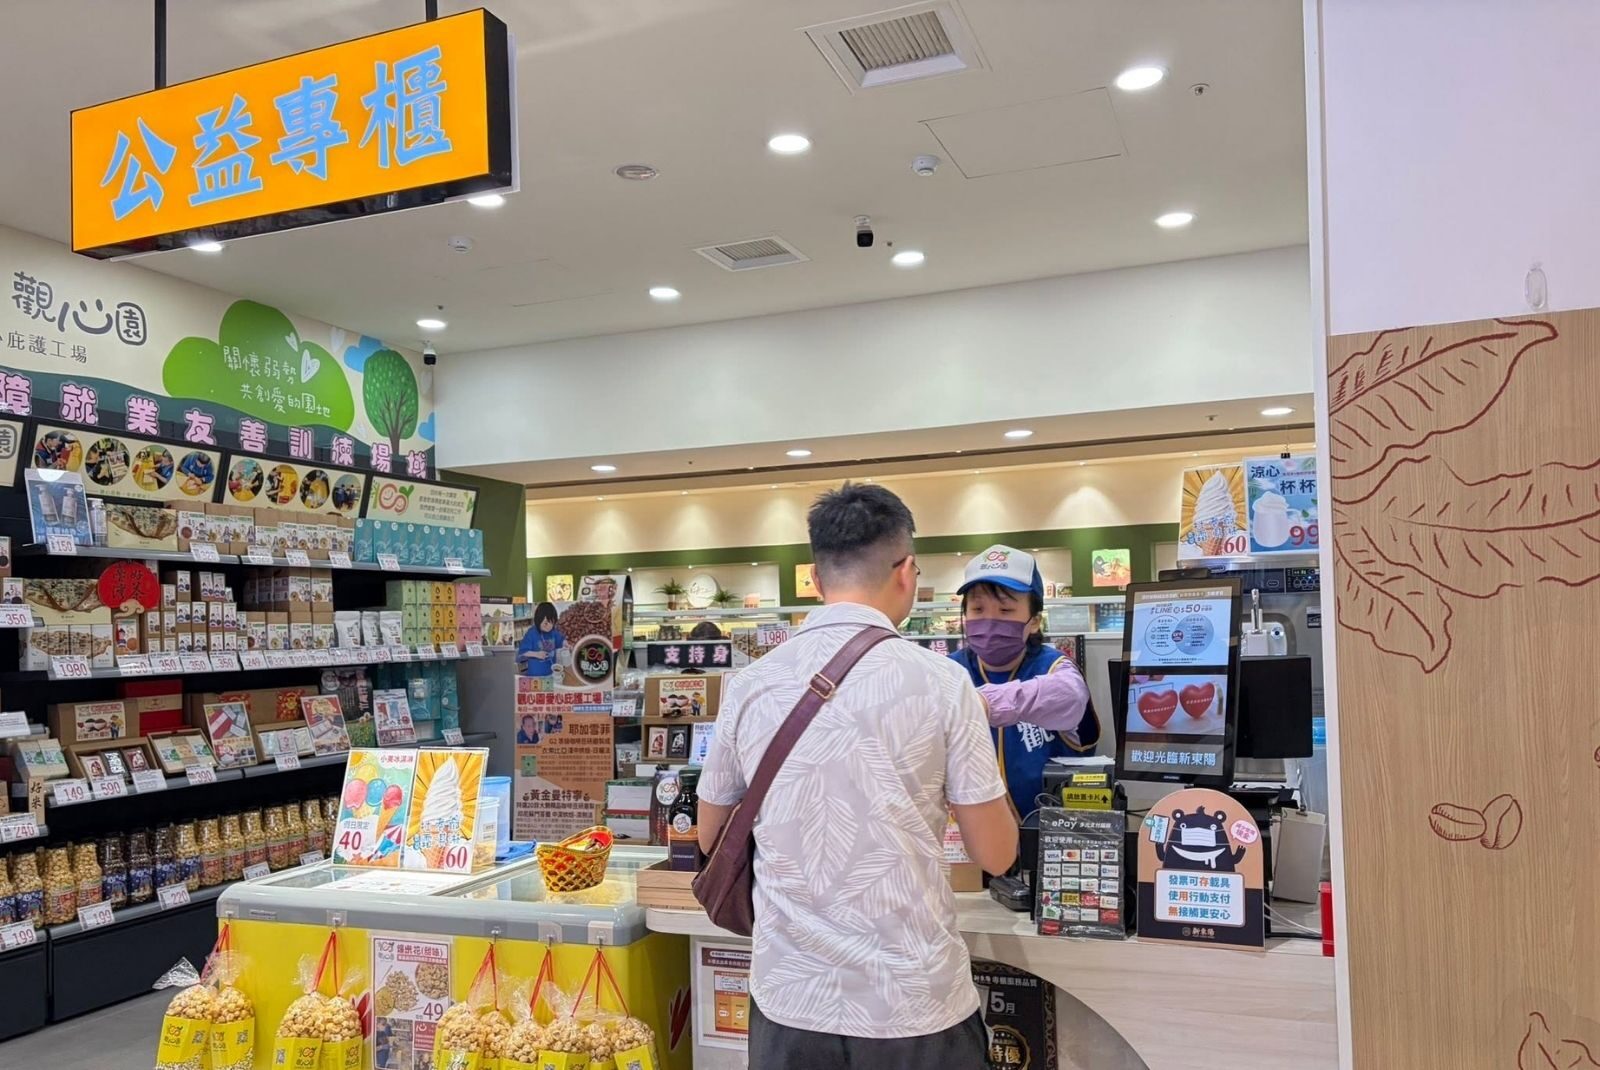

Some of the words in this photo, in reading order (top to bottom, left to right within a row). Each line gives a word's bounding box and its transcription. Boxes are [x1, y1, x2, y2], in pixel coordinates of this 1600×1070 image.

[100, 44, 453, 221] 公益專櫃
[12, 270, 148, 346] 觀心園
[0, 330, 88, 364] 庇護工場
[223, 346, 297, 385] 關懷弱勢
[240, 383, 331, 418] 共創愛的園地
[1251, 465, 1280, 479] 涼心
[1280, 479, 1316, 495] 杯杯
[1290, 525, 1319, 546] 99
[1224, 536, 1247, 553] 60
[6, 613, 28, 626] 350
[763, 630, 788, 645] 1980
[664, 645, 730, 664] 支持身
[59, 662, 88, 677] 1980
[159, 658, 177, 671] 350
[1131, 750, 1217, 767] 歡迎光臨新東陽
[30, 782, 42, 810] 好米
[64, 786, 84, 801] 149
[101, 782, 121, 796] 590
[1052, 819, 1078, 830] ePay
[339, 831, 362, 850] 40
[445, 845, 468, 869] 60
[1168, 875, 1231, 888] 發票可存載具
[171, 890, 189, 905] 220
[1168, 891, 1231, 904] 使用行動支付
[93, 909, 112, 926] 199
[1168, 906, 1231, 920] 無接觸更安心
[13, 928, 35, 946] 199
[990, 991, 1016, 1014] 5月
[423, 1002, 444, 1021] 49
